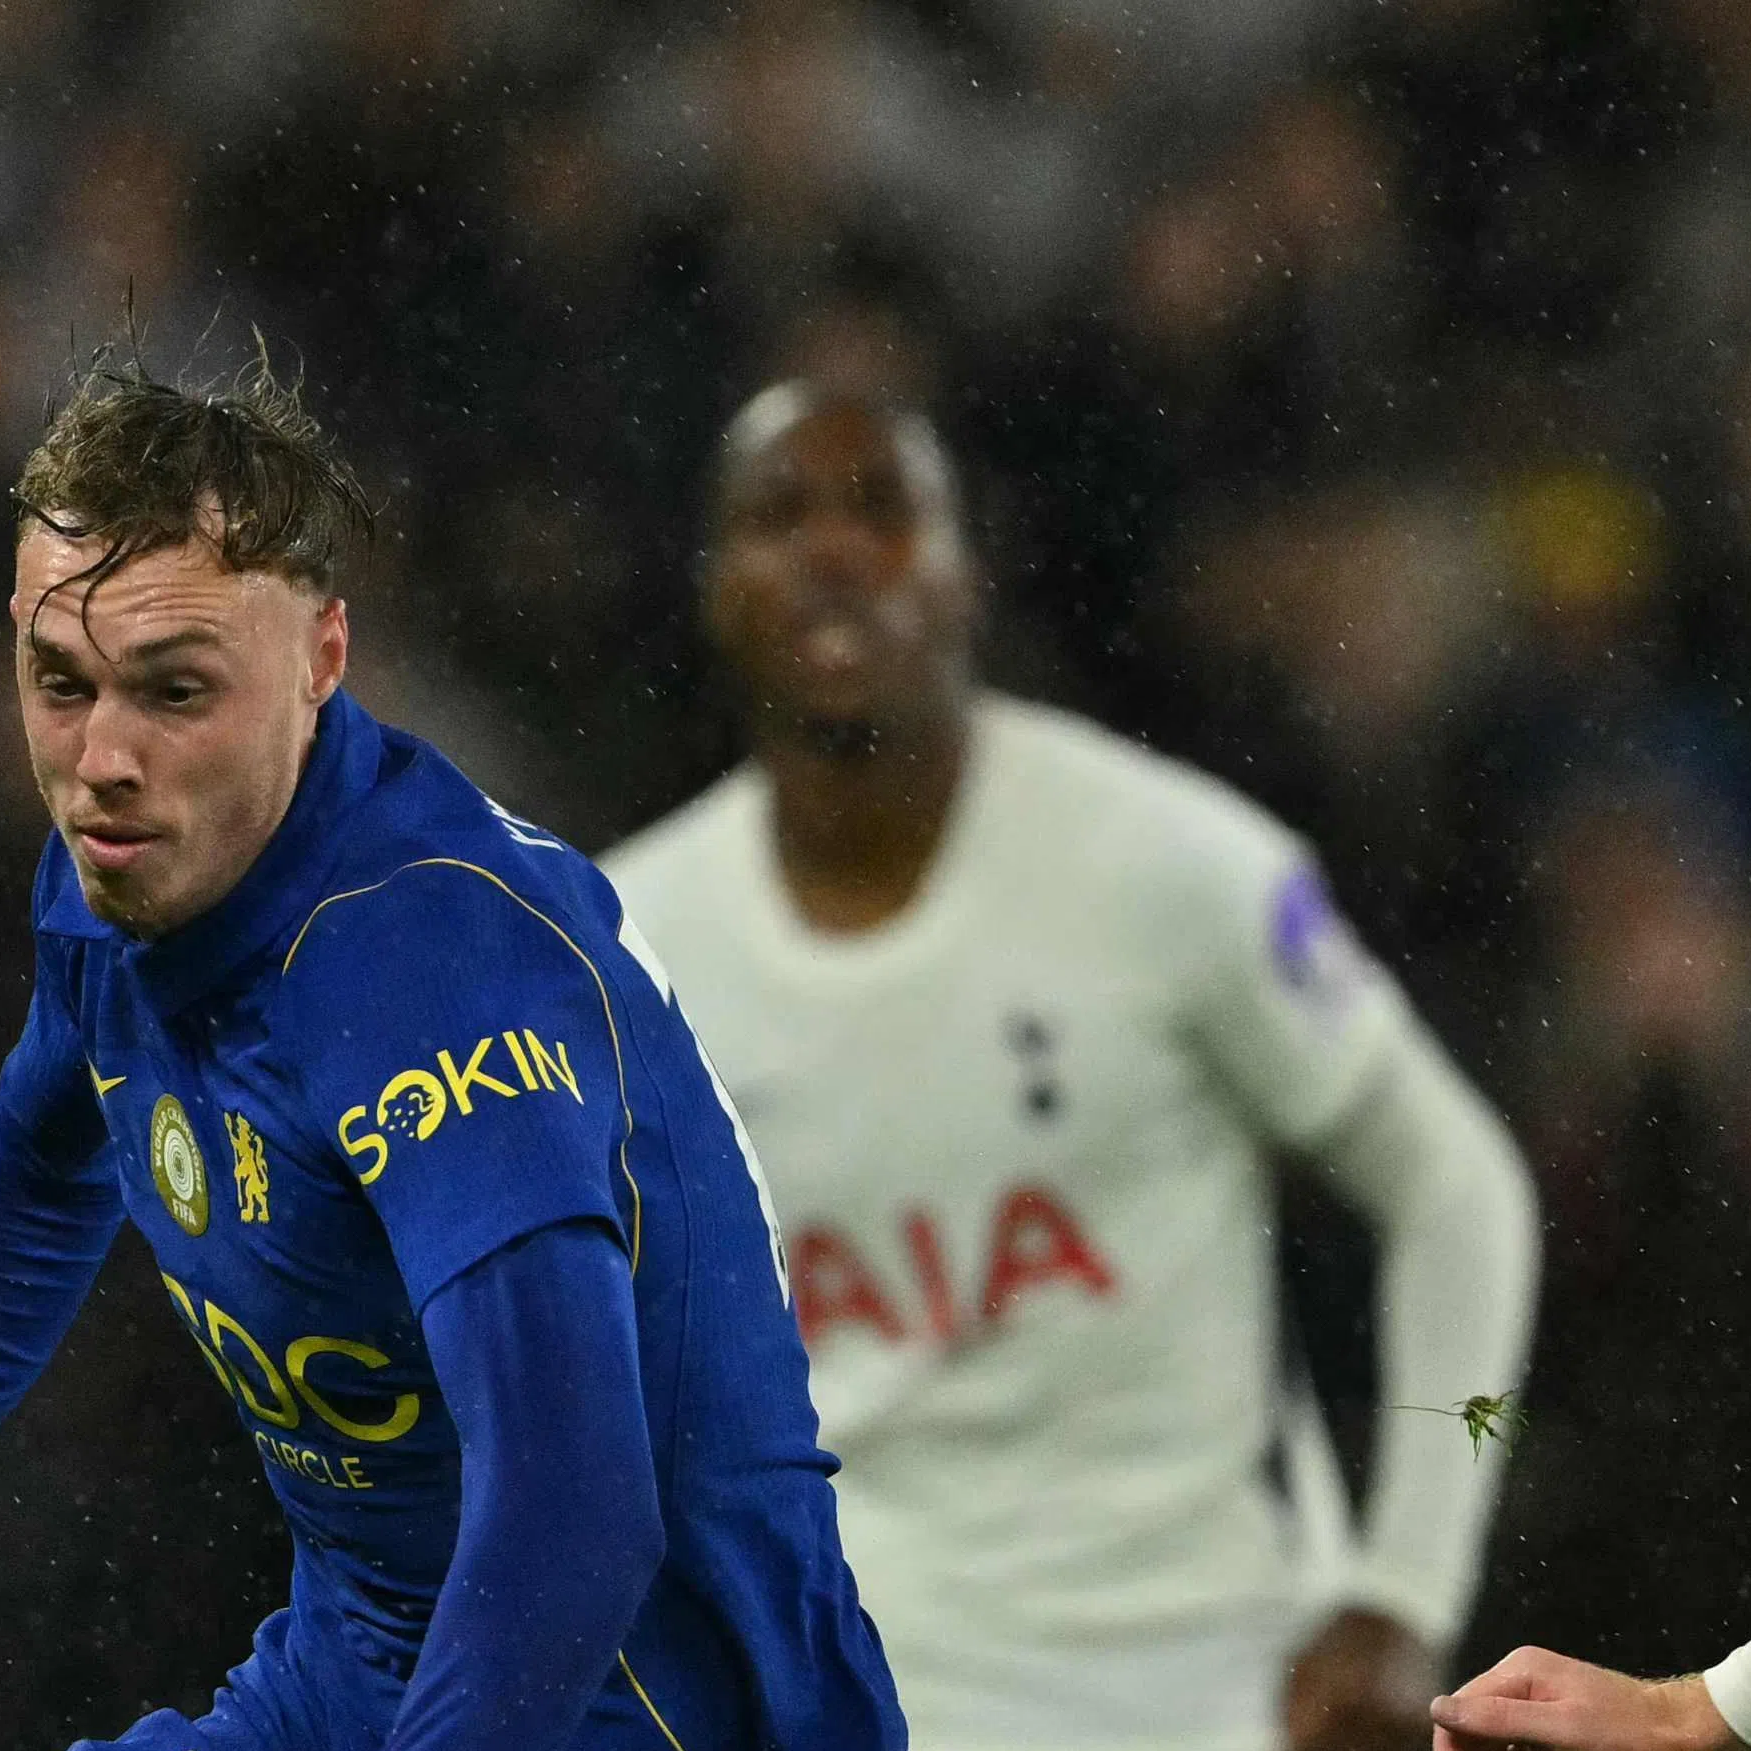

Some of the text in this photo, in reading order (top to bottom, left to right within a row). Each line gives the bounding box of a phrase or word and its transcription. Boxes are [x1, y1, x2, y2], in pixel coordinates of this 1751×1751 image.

[338, 1028, 584, 1185] SOKIN
[172, 1198, 198, 1227] FIFA
[789, 1183, 1123, 1350] AIA
[255, 1431, 374, 1489] CIRCLE
